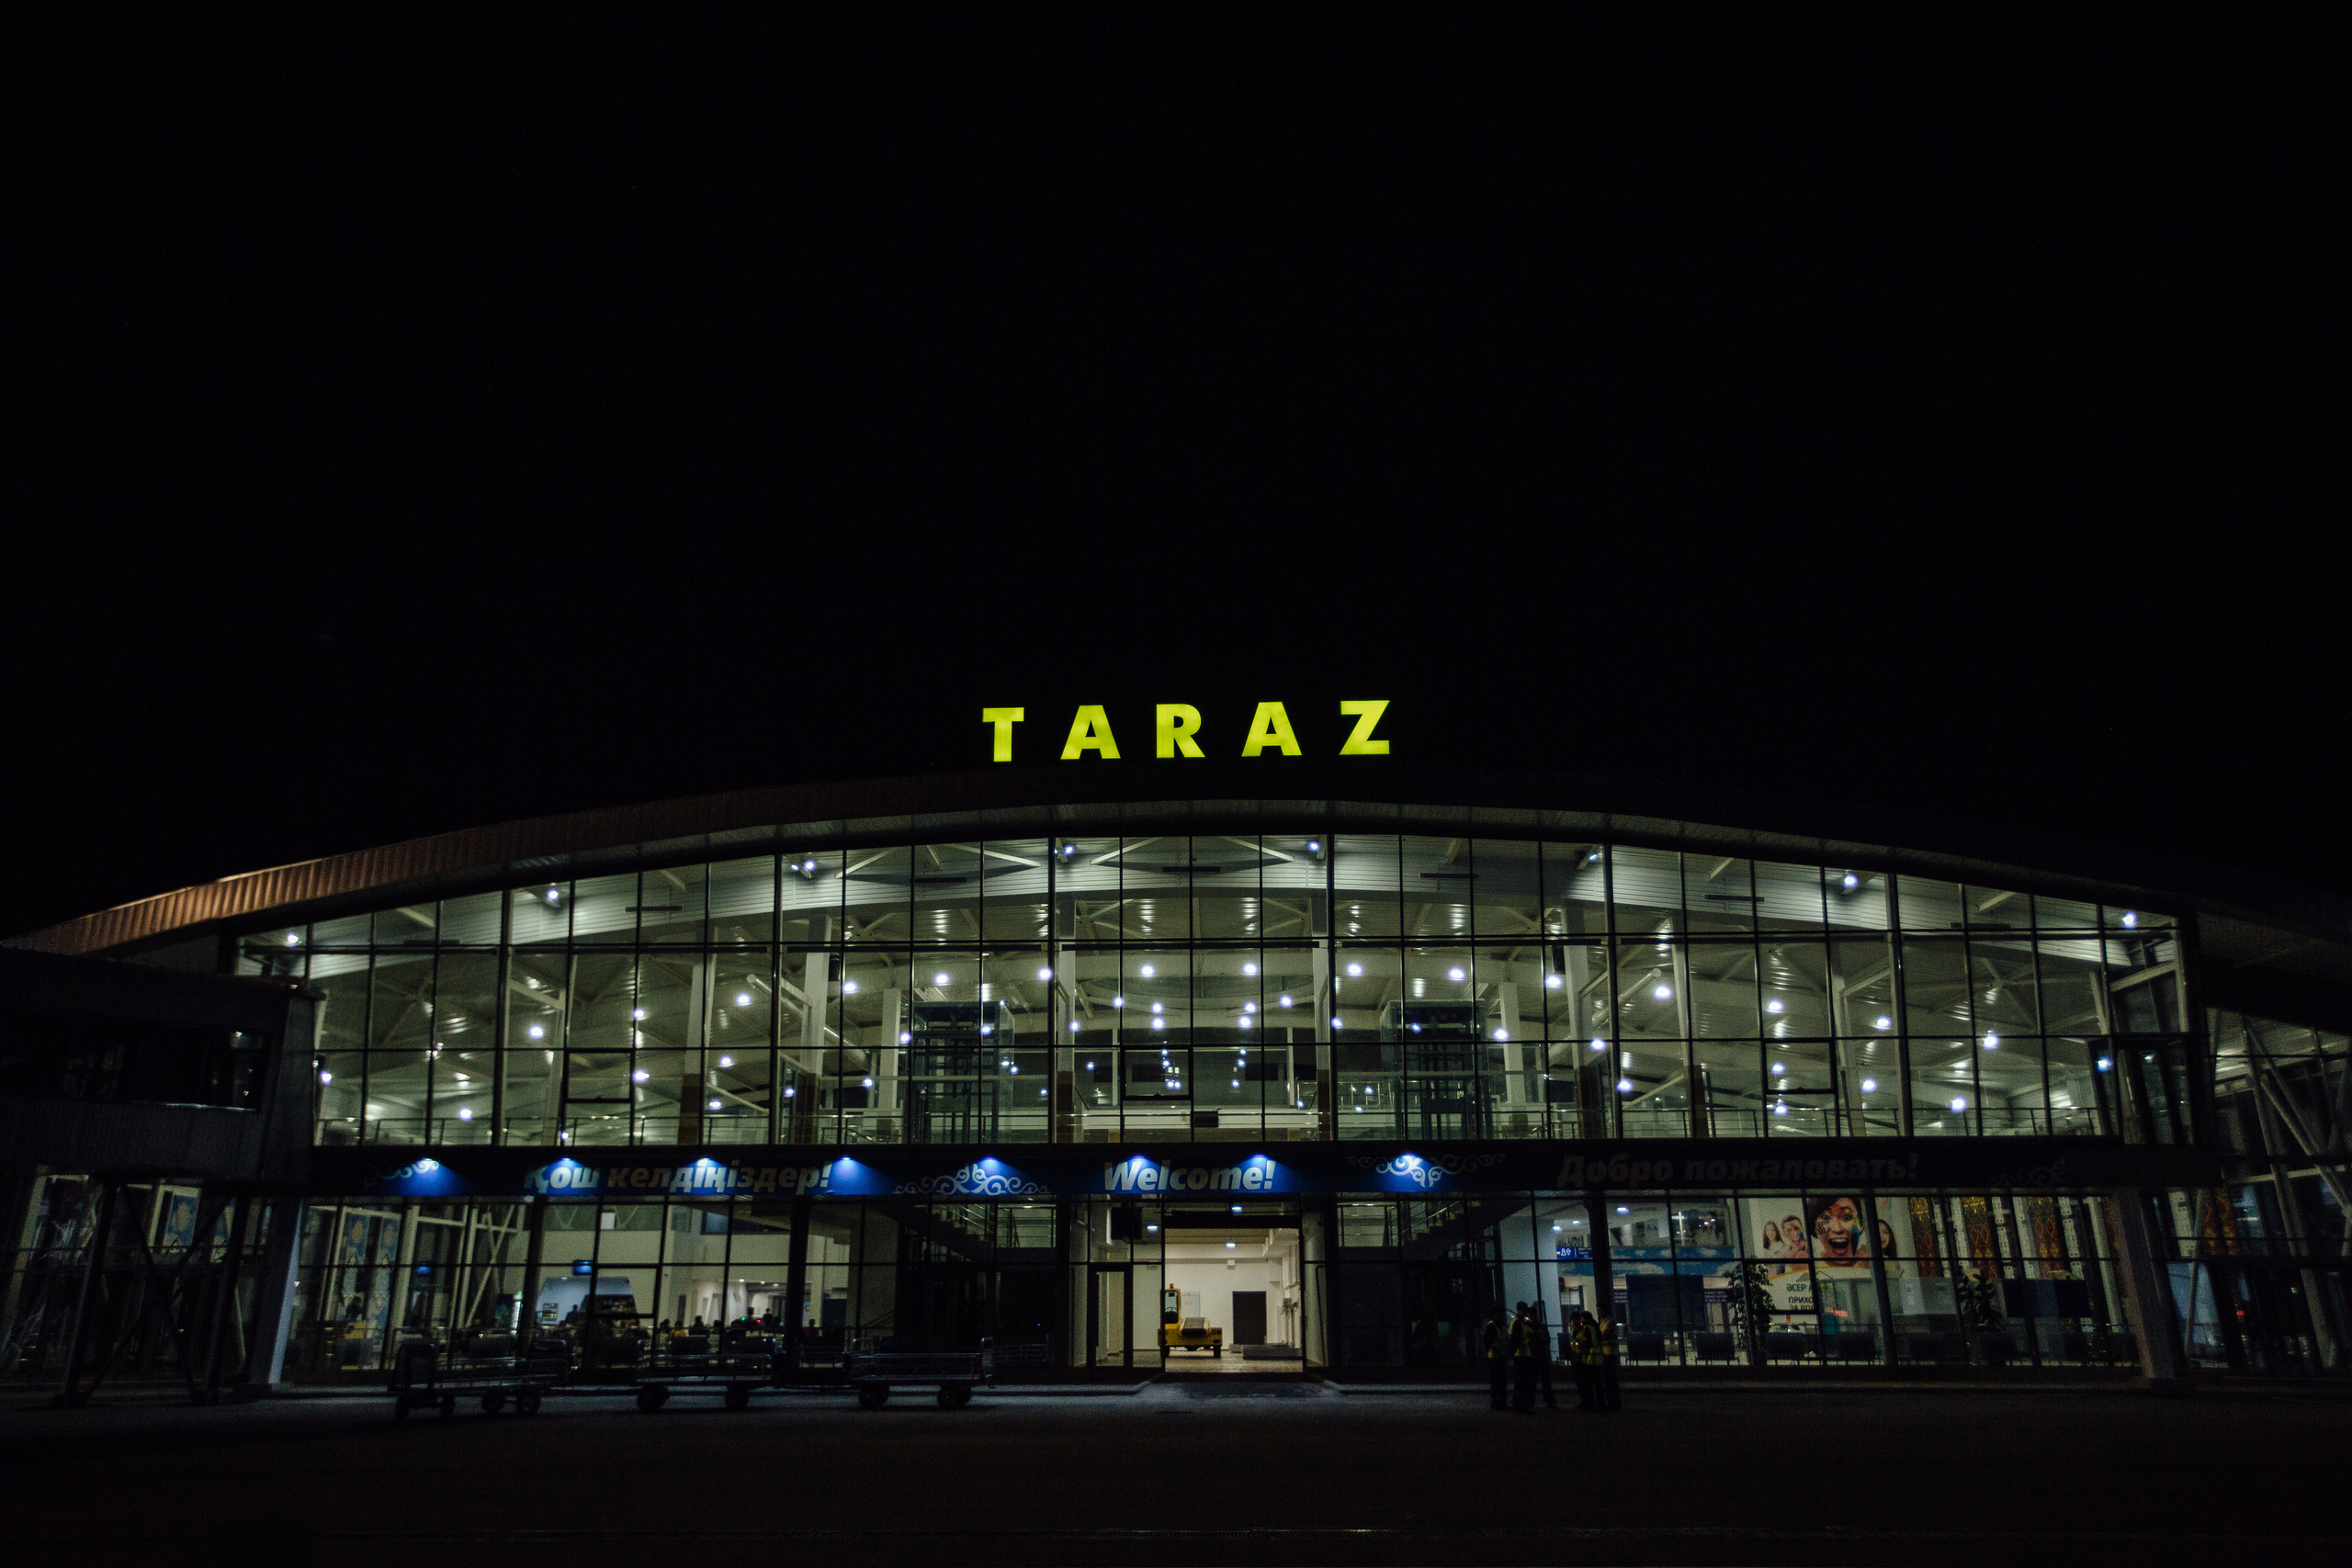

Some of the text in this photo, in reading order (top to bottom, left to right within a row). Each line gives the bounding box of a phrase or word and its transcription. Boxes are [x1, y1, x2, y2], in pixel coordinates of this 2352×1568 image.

[982, 700, 1392, 763] TARAZ
[523, 1165, 600, 1194] Қош
[1104, 1159, 1276, 1190] Welcome!
[1556, 1153, 1919, 1189] Добро пожаловать!
